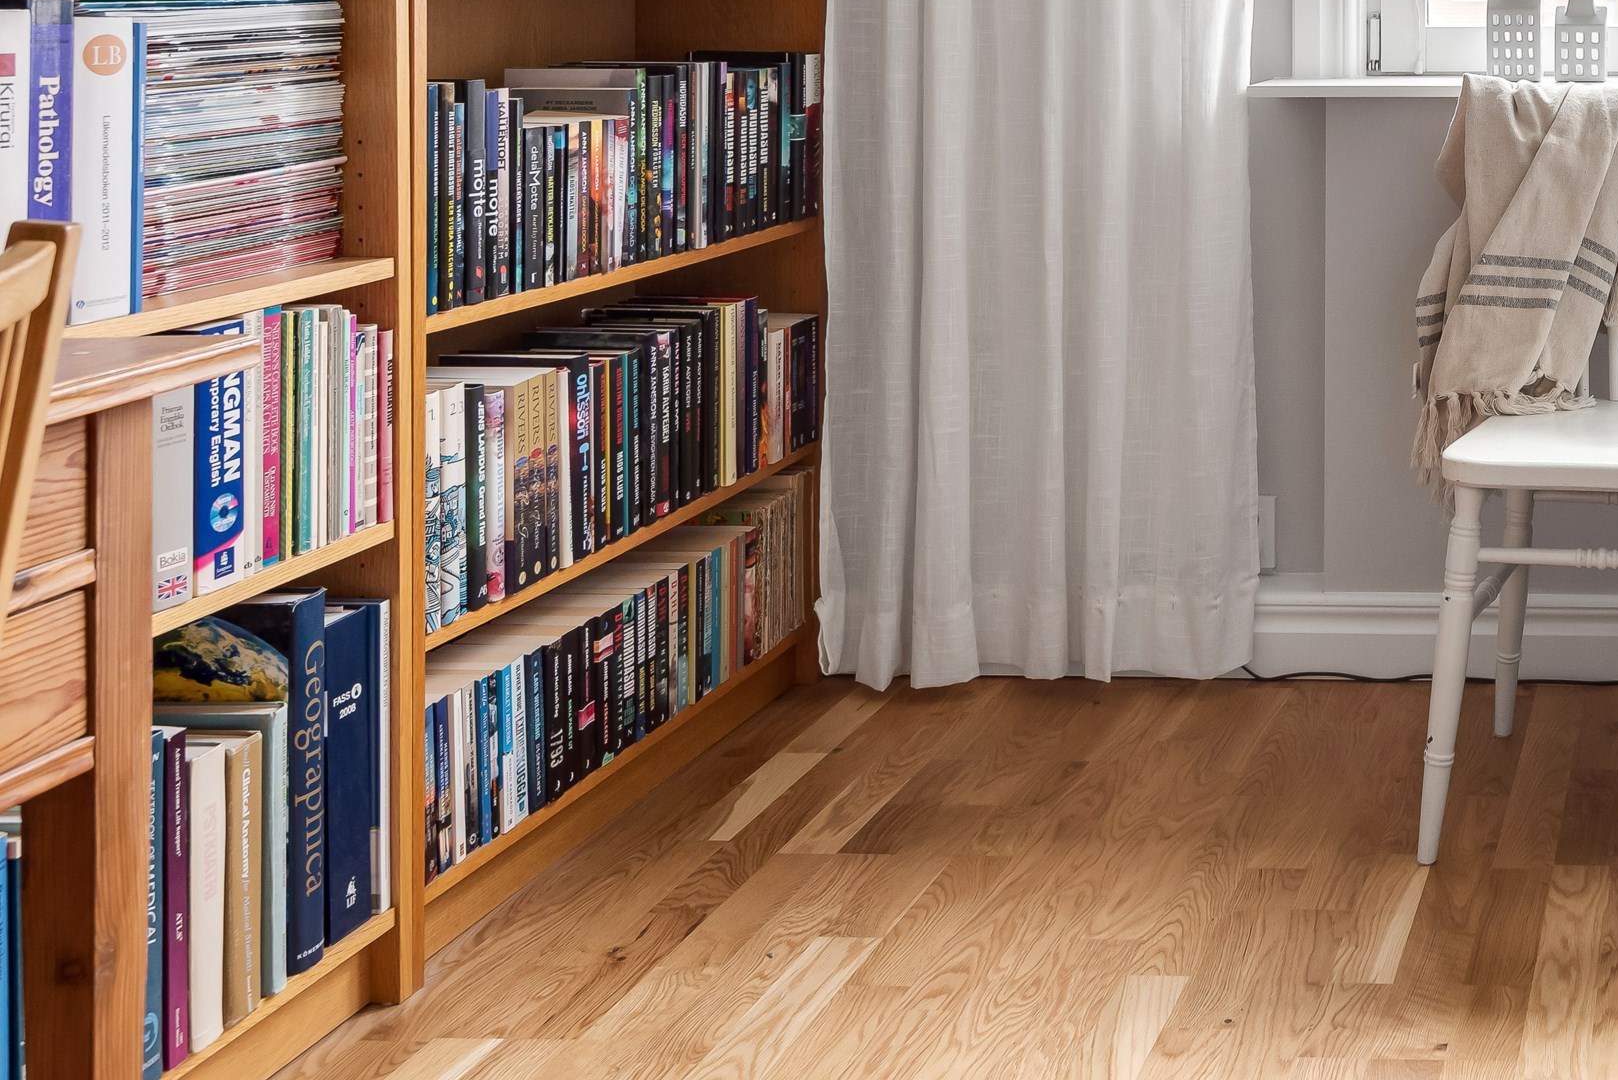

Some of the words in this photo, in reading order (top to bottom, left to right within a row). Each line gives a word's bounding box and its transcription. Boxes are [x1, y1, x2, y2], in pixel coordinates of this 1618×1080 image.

[91, 46, 122, 66] LB
[0, 82, 15, 149] Kirurgi
[33, 75, 60, 206] Pathology
[498, 102, 506, 171] KALLENTOFT
[102, 115, 110, 200] Läkemedelsboken
[469, 159, 483, 218] motte
[485, 179, 498, 236] motte
[263, 342, 271, 371] BIBLE
[271, 371, 279, 426] COMPLETE
[518, 393, 526, 454] RIVERS
[532, 385, 540, 445] RIVERS
[576, 374, 588, 441] Ohlsson
[161, 422, 184, 432] Ordbok
[271, 428, 279, 455] BOOK
[159, 551, 186, 568] Bokia
[613, 612, 623, 651] DAHL
[333, 692, 351, 708] FASS
[339, 702, 356, 720] 2008
[294, 639, 325, 897] Geographica
[549, 728, 564, 768] 1793
[568, 741, 573, 750] UT
[242, 768, 250, 819] Clinical
[203, 803, 217, 901] PSYKIATRI
[241, 820, 250, 878] Anatomy
[346, 894, 357, 909] LIF
[245, 935, 253, 972] Students
